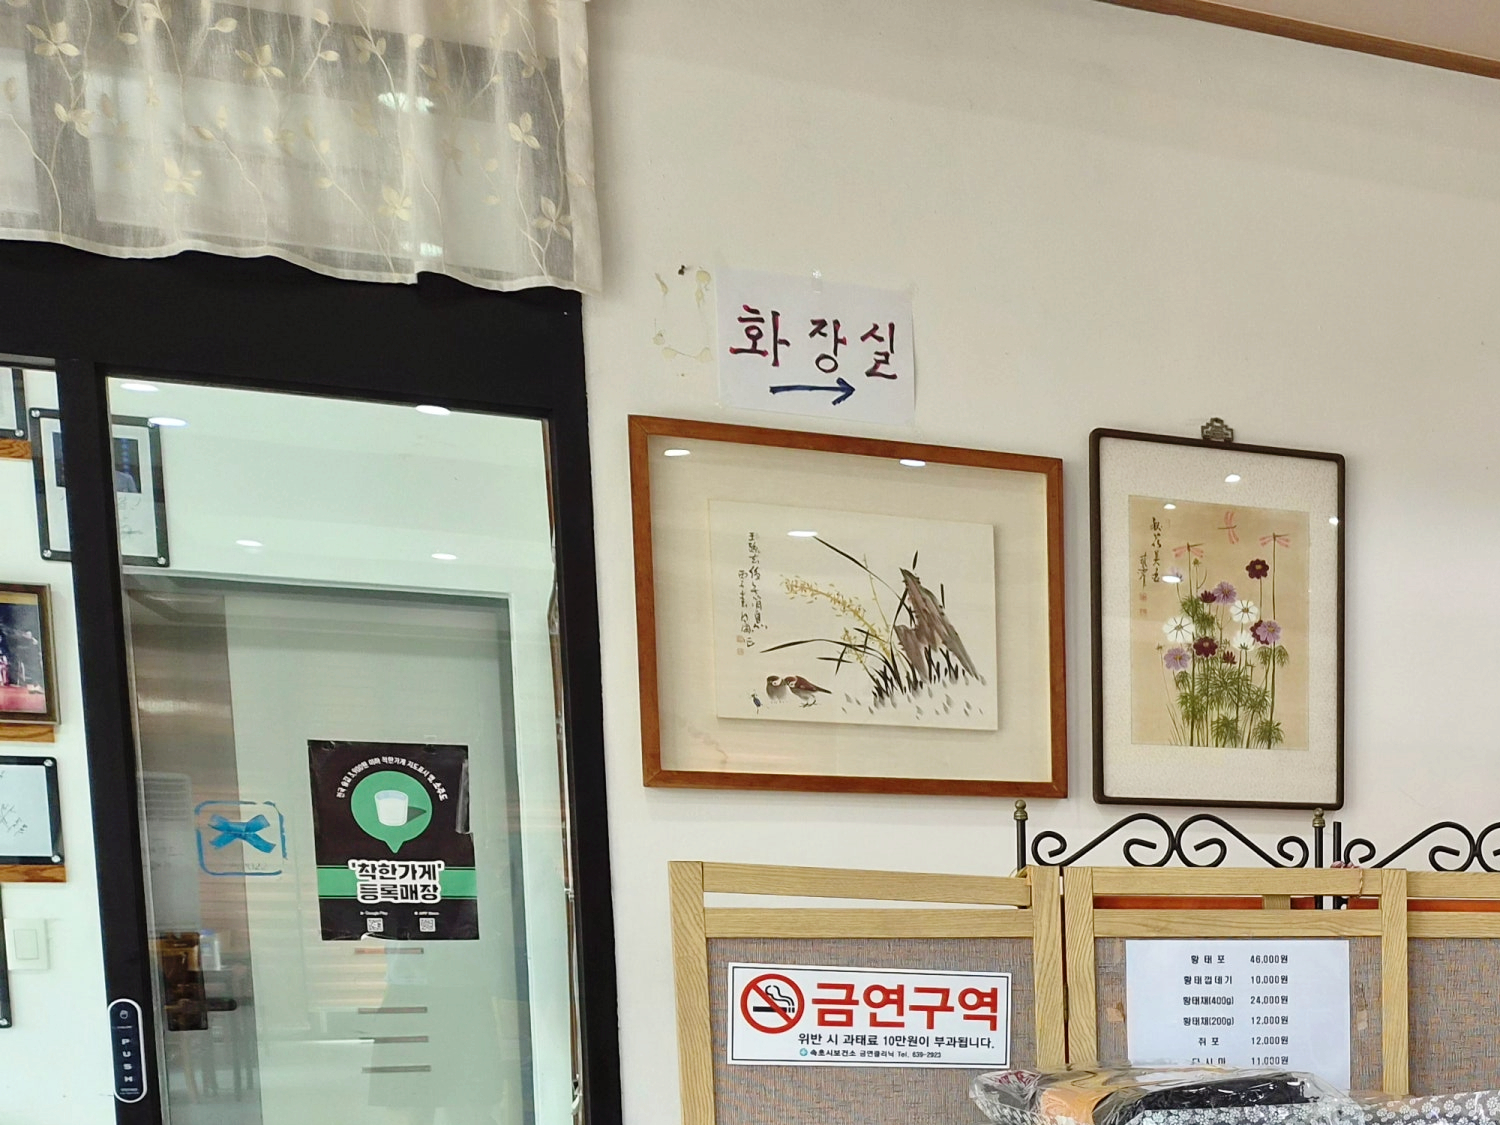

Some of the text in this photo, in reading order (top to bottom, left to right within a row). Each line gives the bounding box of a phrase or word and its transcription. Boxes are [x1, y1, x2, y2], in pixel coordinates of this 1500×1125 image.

[360, 884, 440, 901] 등록매장
[812, 982, 998, 1031] 금연구역
[798, 1033, 995, 1050] 위반 시 과태료 10만원이 부과됩니다.
[810, 1049, 857, 1057] 속초시보건소
